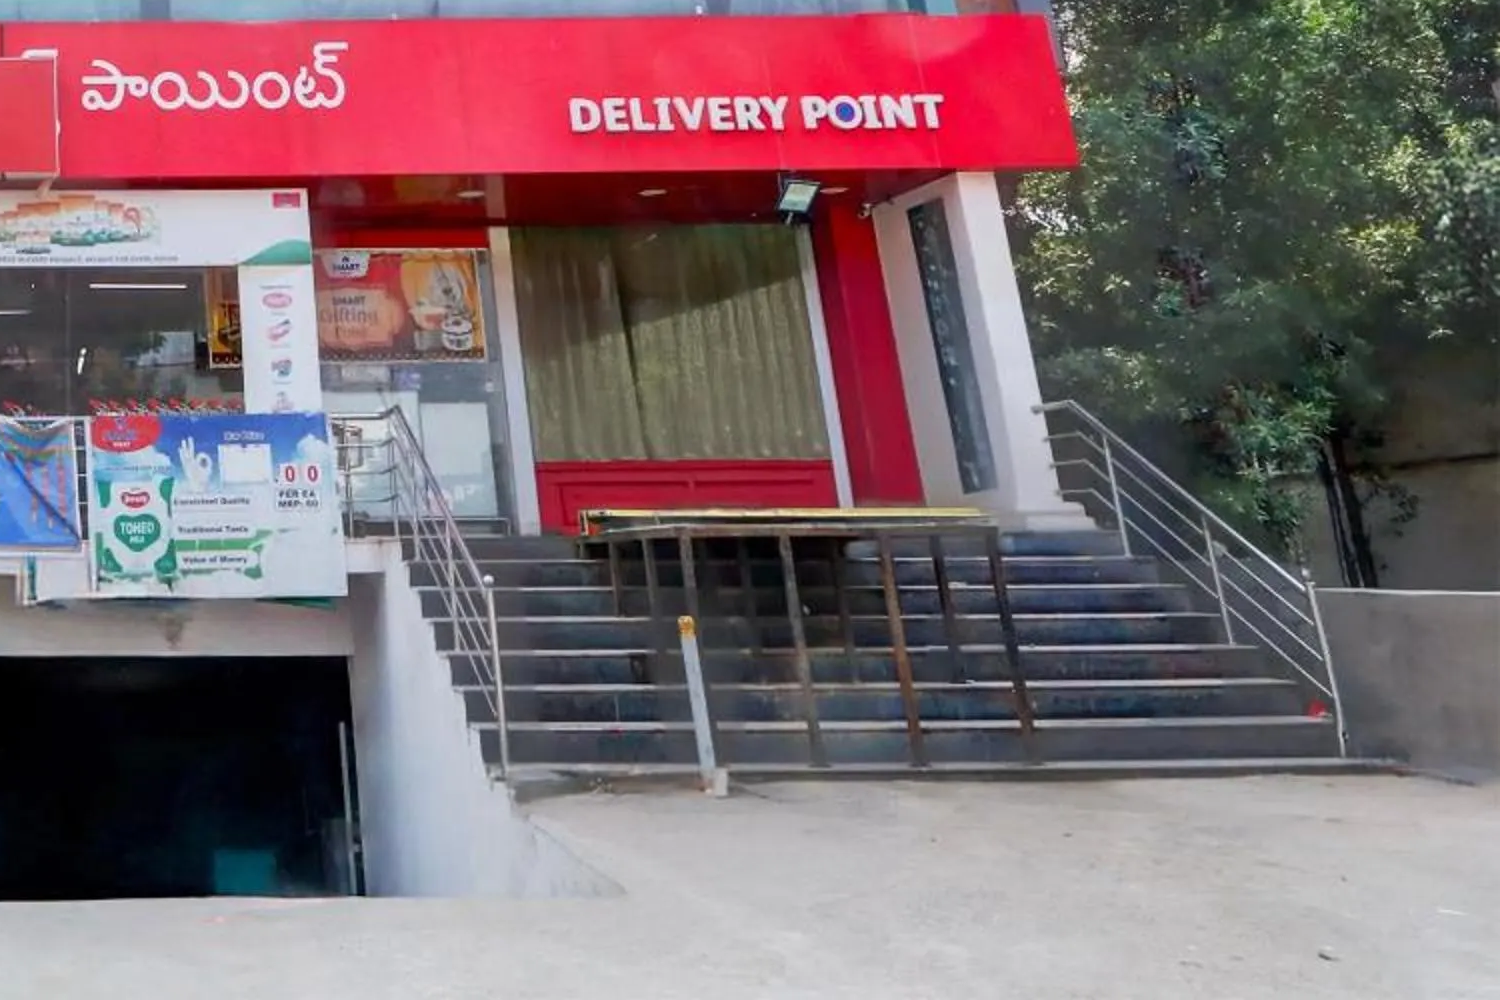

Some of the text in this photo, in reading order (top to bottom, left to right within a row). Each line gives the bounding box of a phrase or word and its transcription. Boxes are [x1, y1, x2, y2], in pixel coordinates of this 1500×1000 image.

[81, 41, 349, 111] పాయింట్
[568, 93, 944, 133] DELIVERY POINT
